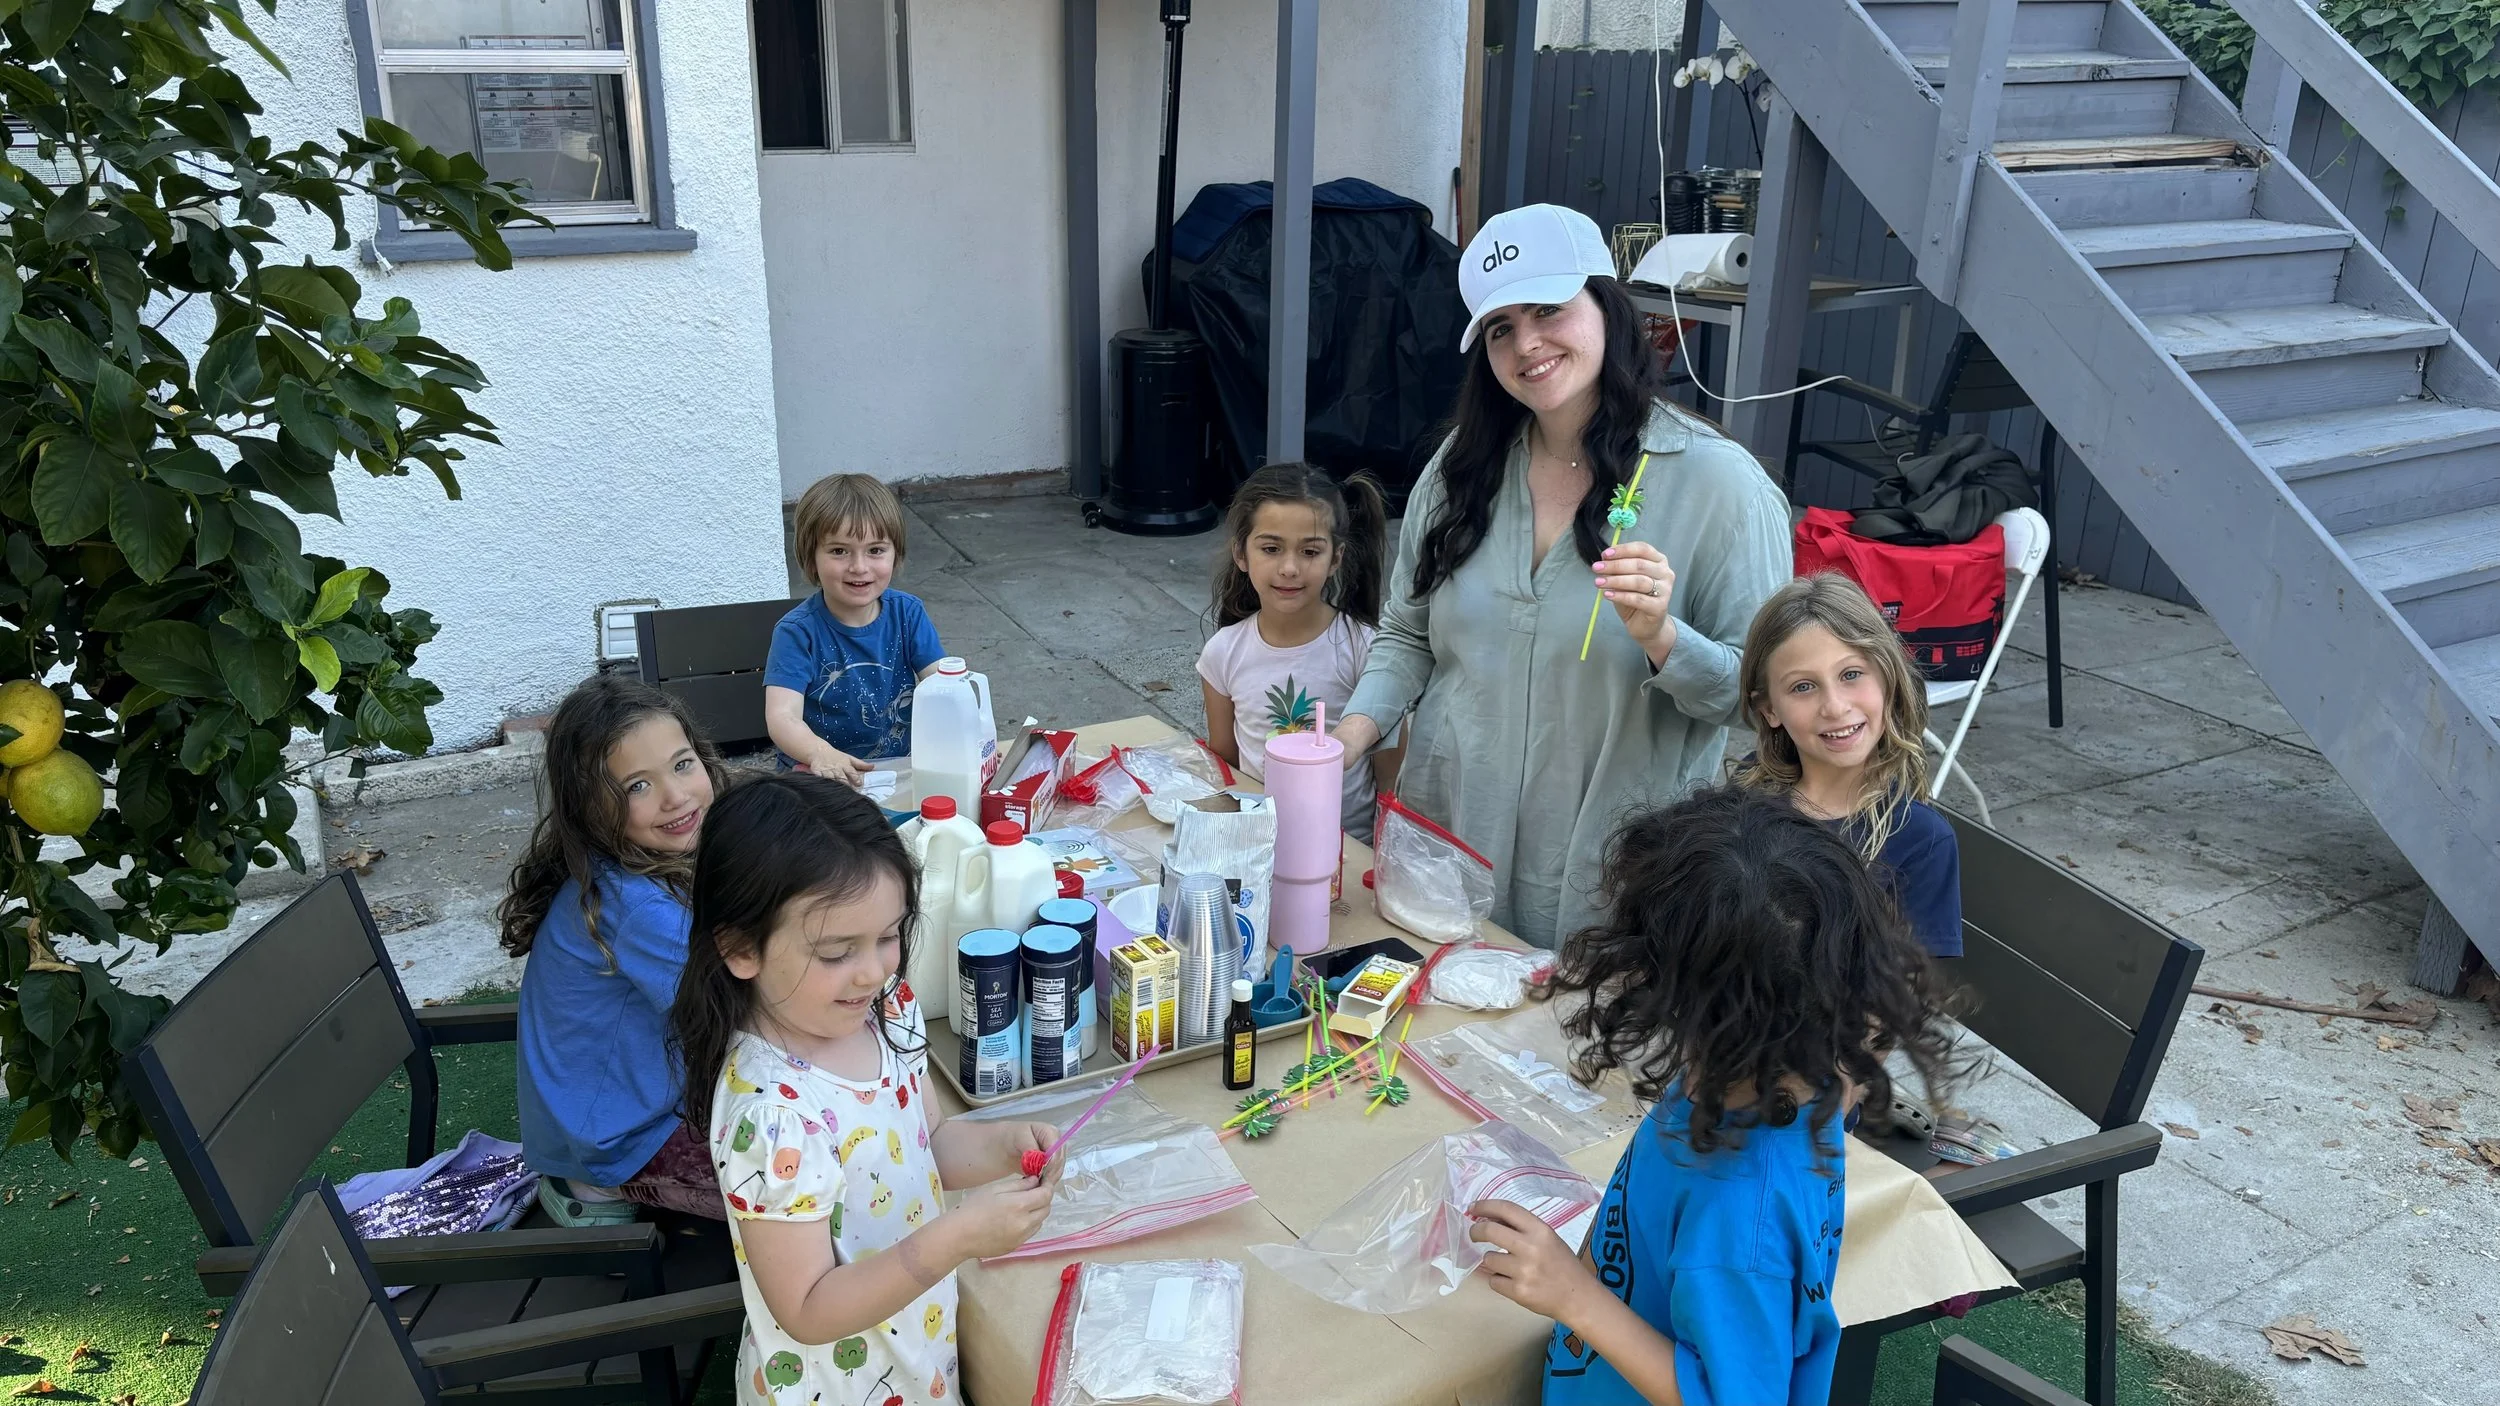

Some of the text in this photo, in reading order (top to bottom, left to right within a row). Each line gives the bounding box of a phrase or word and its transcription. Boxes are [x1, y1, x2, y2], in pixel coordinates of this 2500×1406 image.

[1482, 241, 1519, 273] alo
[984, 992, 1008, 1000] MORTON
[1355, 986, 1382, 997] GEFEN
[1600, 1205, 1627, 1298] BISO
